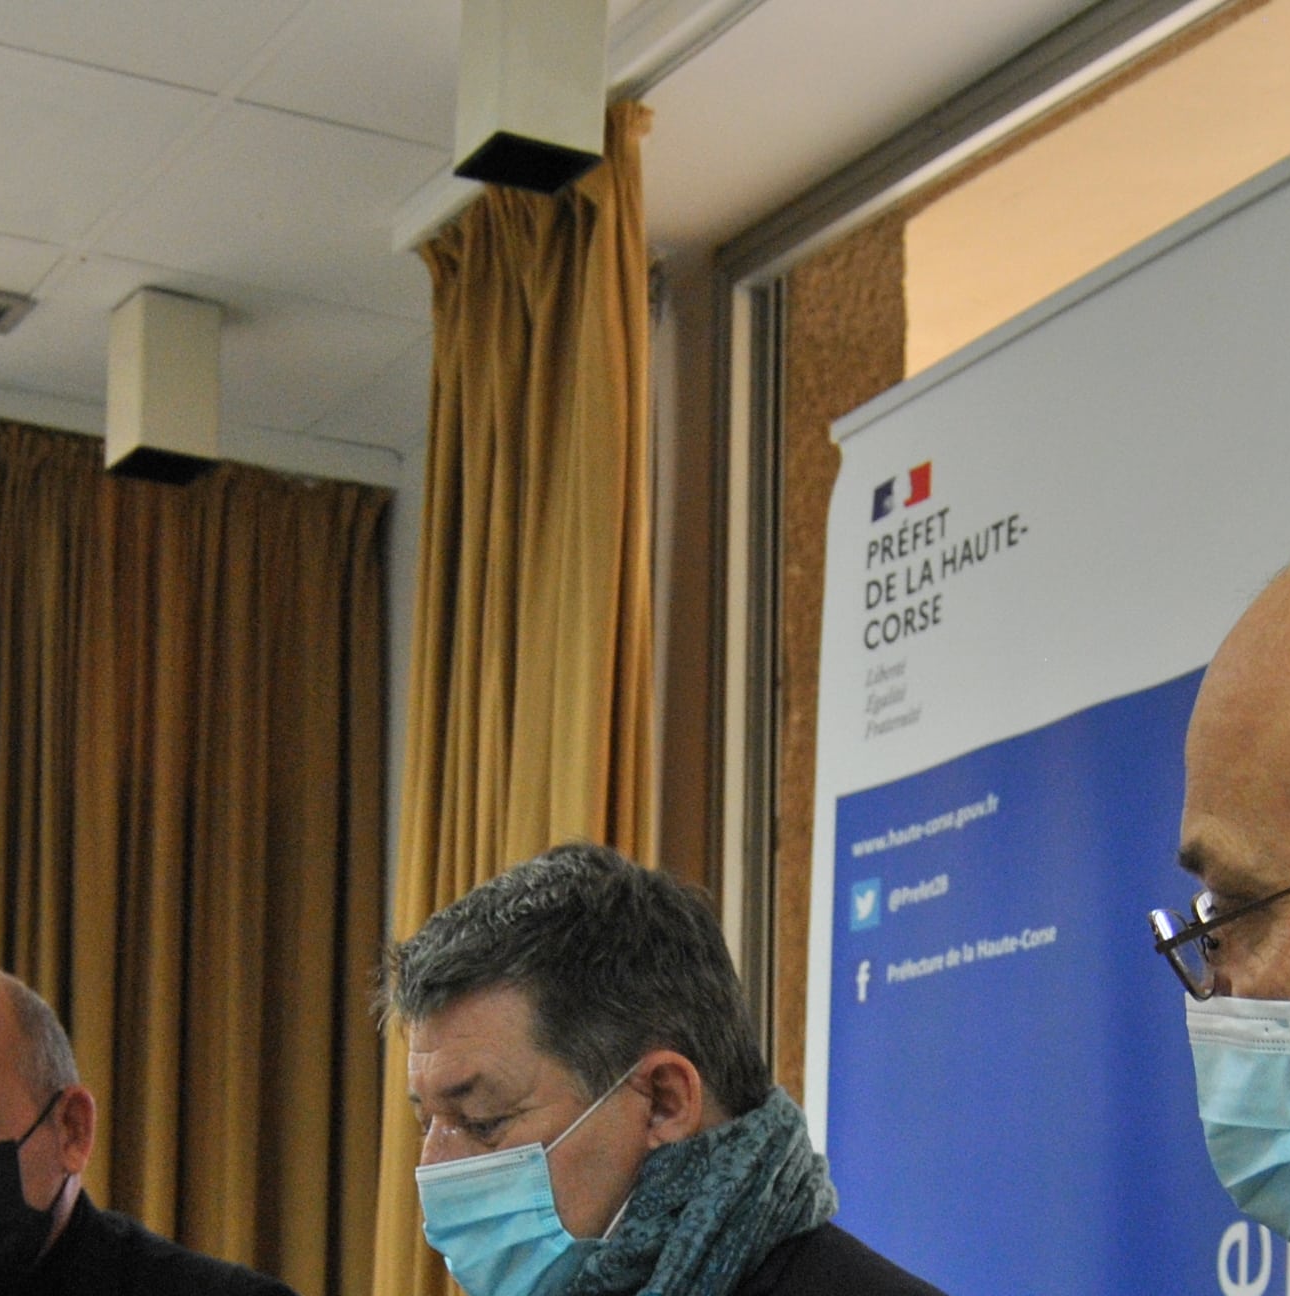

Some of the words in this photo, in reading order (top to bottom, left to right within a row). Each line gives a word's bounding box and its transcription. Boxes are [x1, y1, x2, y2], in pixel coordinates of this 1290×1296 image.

[865, 572, 897, 610] DE
[906, 557, 935, 595] LA
[940, 513, 1029, 580] HAUTE-
[866, 506, 950, 569] PRÉFET
[863, 593, 943, 650] CORSE
[852, 792, 999, 857] www.haute-corse.gouv.fr
[945, 947, 960, 968] de
[962, 942, 974, 963] la
[976, 925, 1057, 959] Haute-Corse
